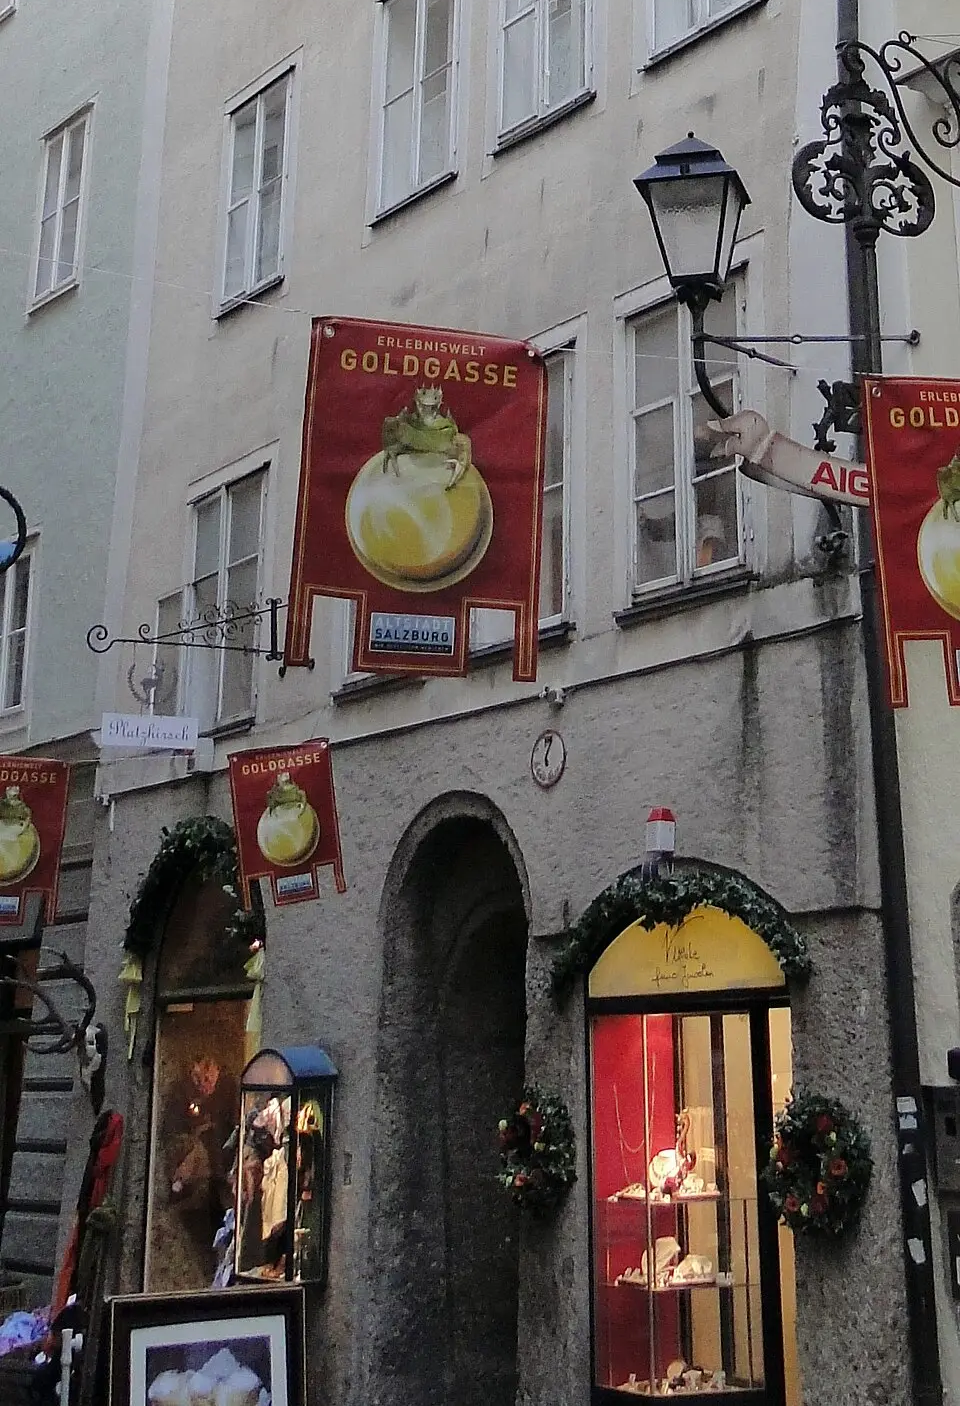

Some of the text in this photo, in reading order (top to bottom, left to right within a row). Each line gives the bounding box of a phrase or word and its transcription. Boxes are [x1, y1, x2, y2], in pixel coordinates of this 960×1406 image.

[377, 335, 486, 356] ERLEBNISWELT
[340, 348, 518, 387] GOLDGASSE
[920, 390, 960, 402] ERLEB
[108, 720, 189, 746] Platzhirsch
[242, 752, 321, 775] GOLDGASSE
